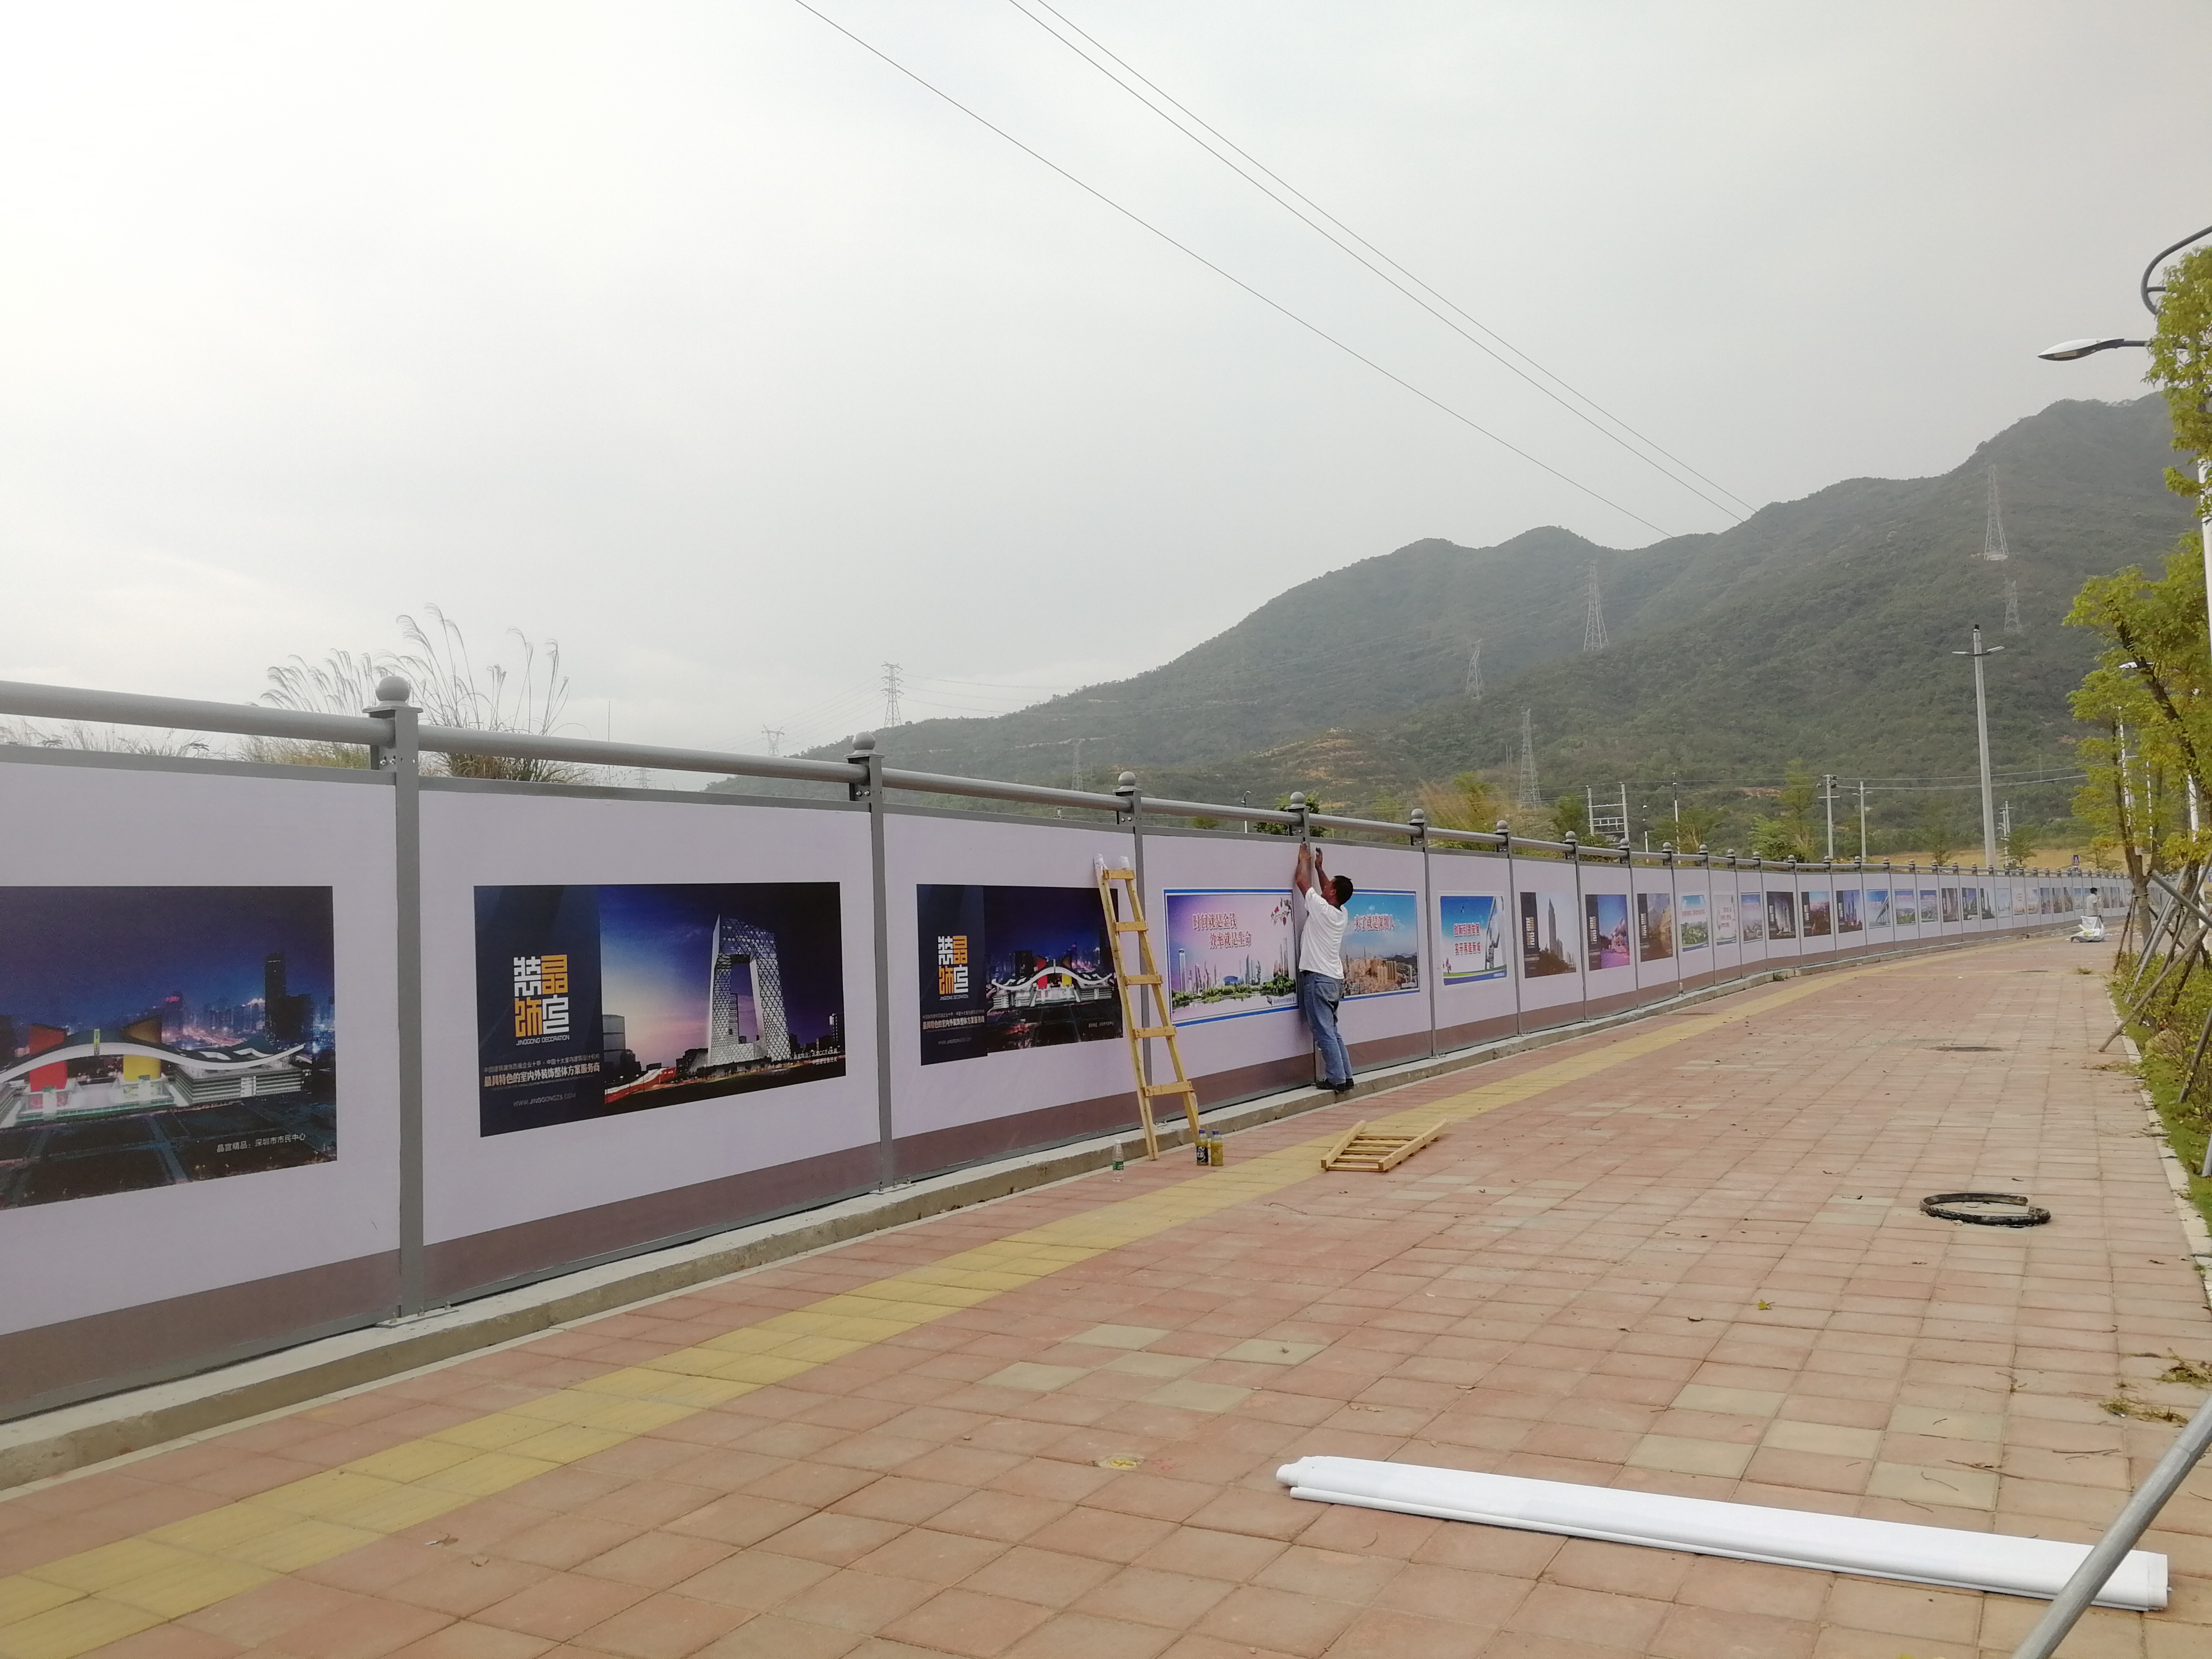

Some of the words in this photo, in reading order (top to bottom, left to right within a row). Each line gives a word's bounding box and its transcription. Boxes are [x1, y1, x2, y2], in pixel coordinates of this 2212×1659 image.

[1193, 913, 1237, 930] 时间就是金钱
[1355, 914, 1394, 931] 来了就是深圳人
[1210, 932, 1251, 949] 效率就是生命
[516, 1037, 541, 1046] JINGGONG
[541, 1035, 570, 1043] DECORATION
[484, 1063, 600, 1087] 最具特色的室内外装饰整体方案服务商
